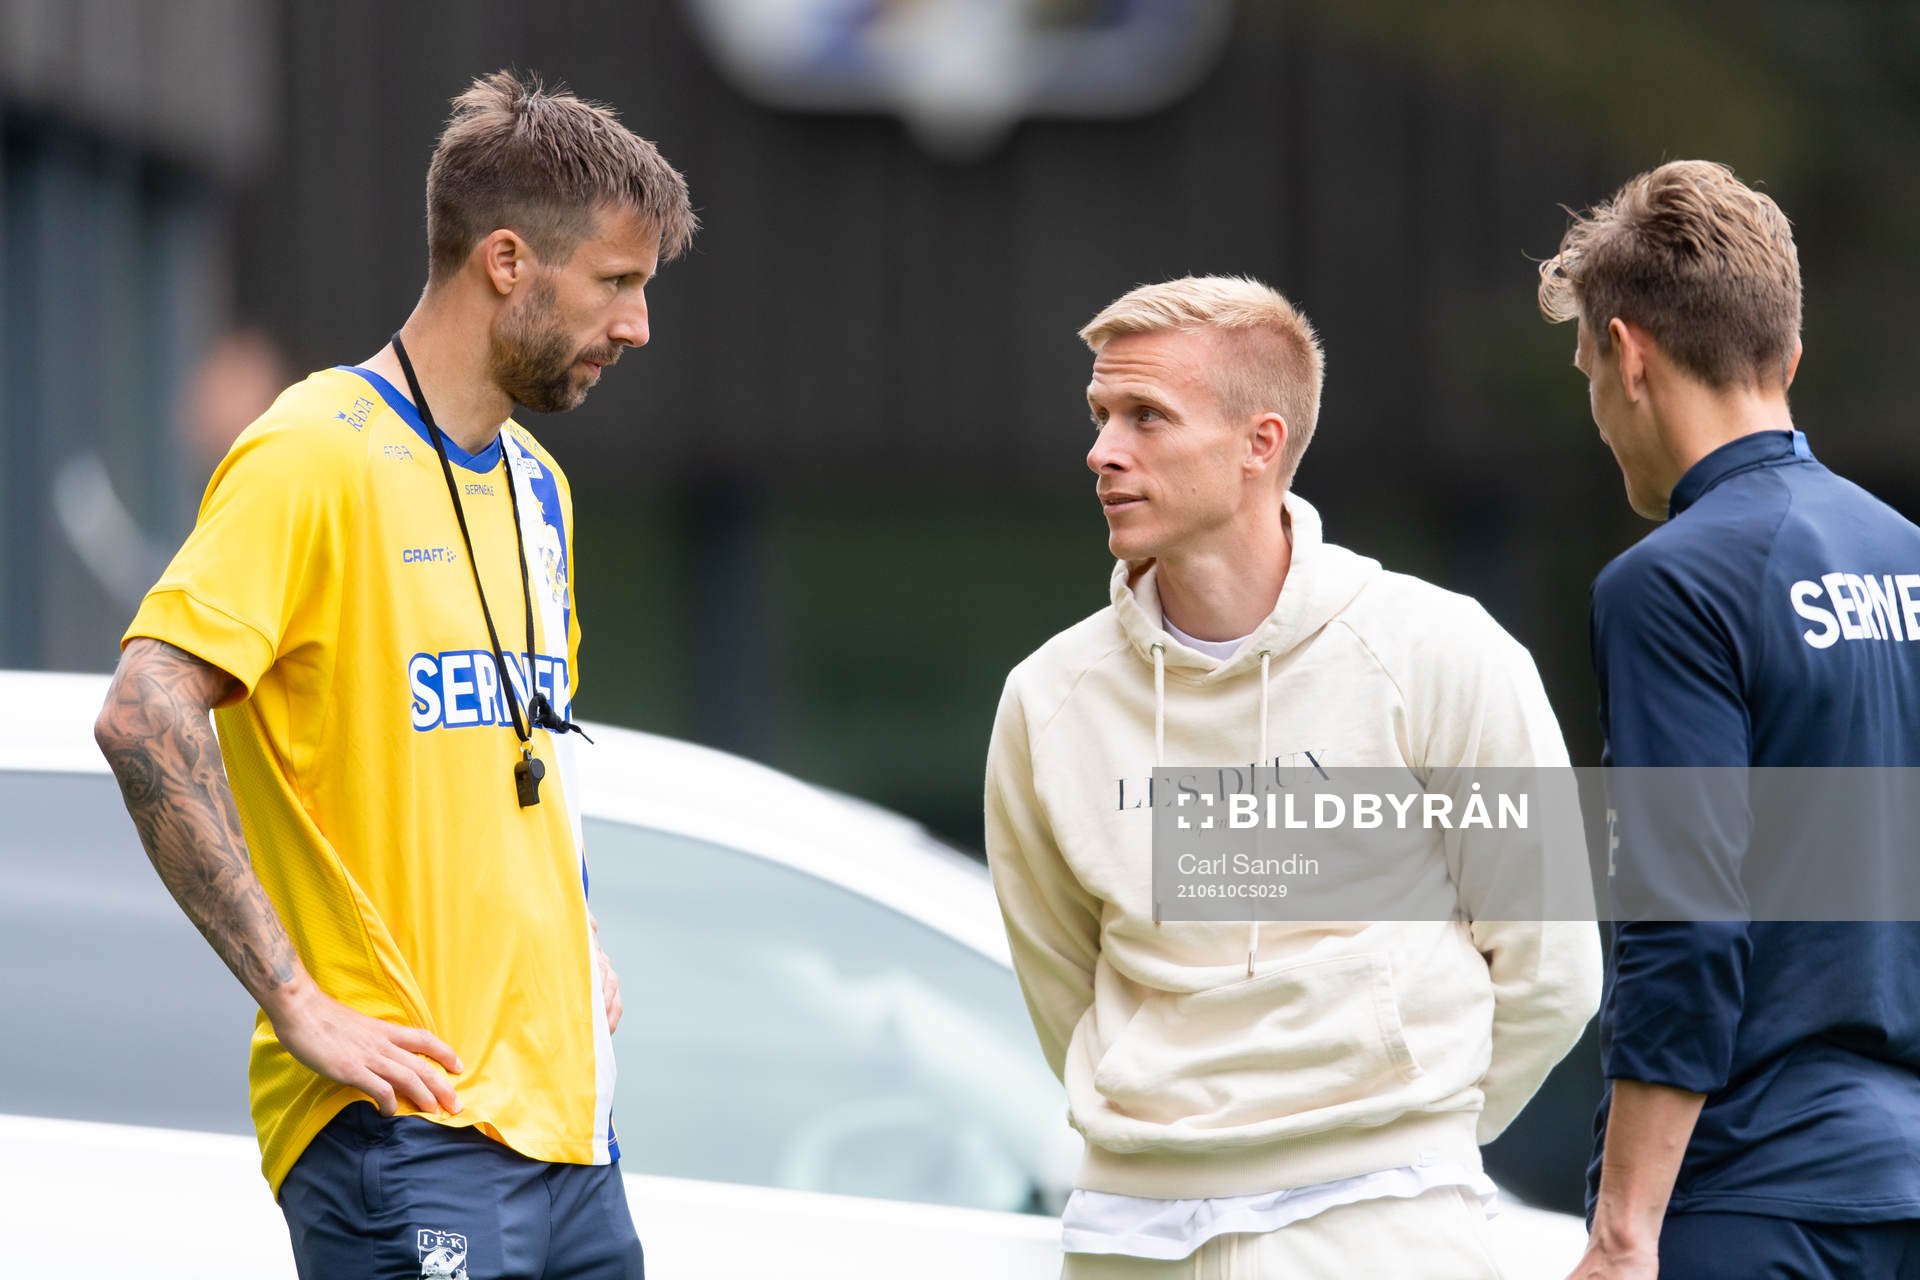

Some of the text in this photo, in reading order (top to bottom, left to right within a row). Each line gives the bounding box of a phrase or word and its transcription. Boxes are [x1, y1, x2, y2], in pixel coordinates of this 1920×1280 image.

[346, 396, 375, 432] RASTA
[464, 484, 495, 497] SERNEKE
[403, 548, 444, 563] CRAFT
[1790, 572, 1920, 649] SERNE
